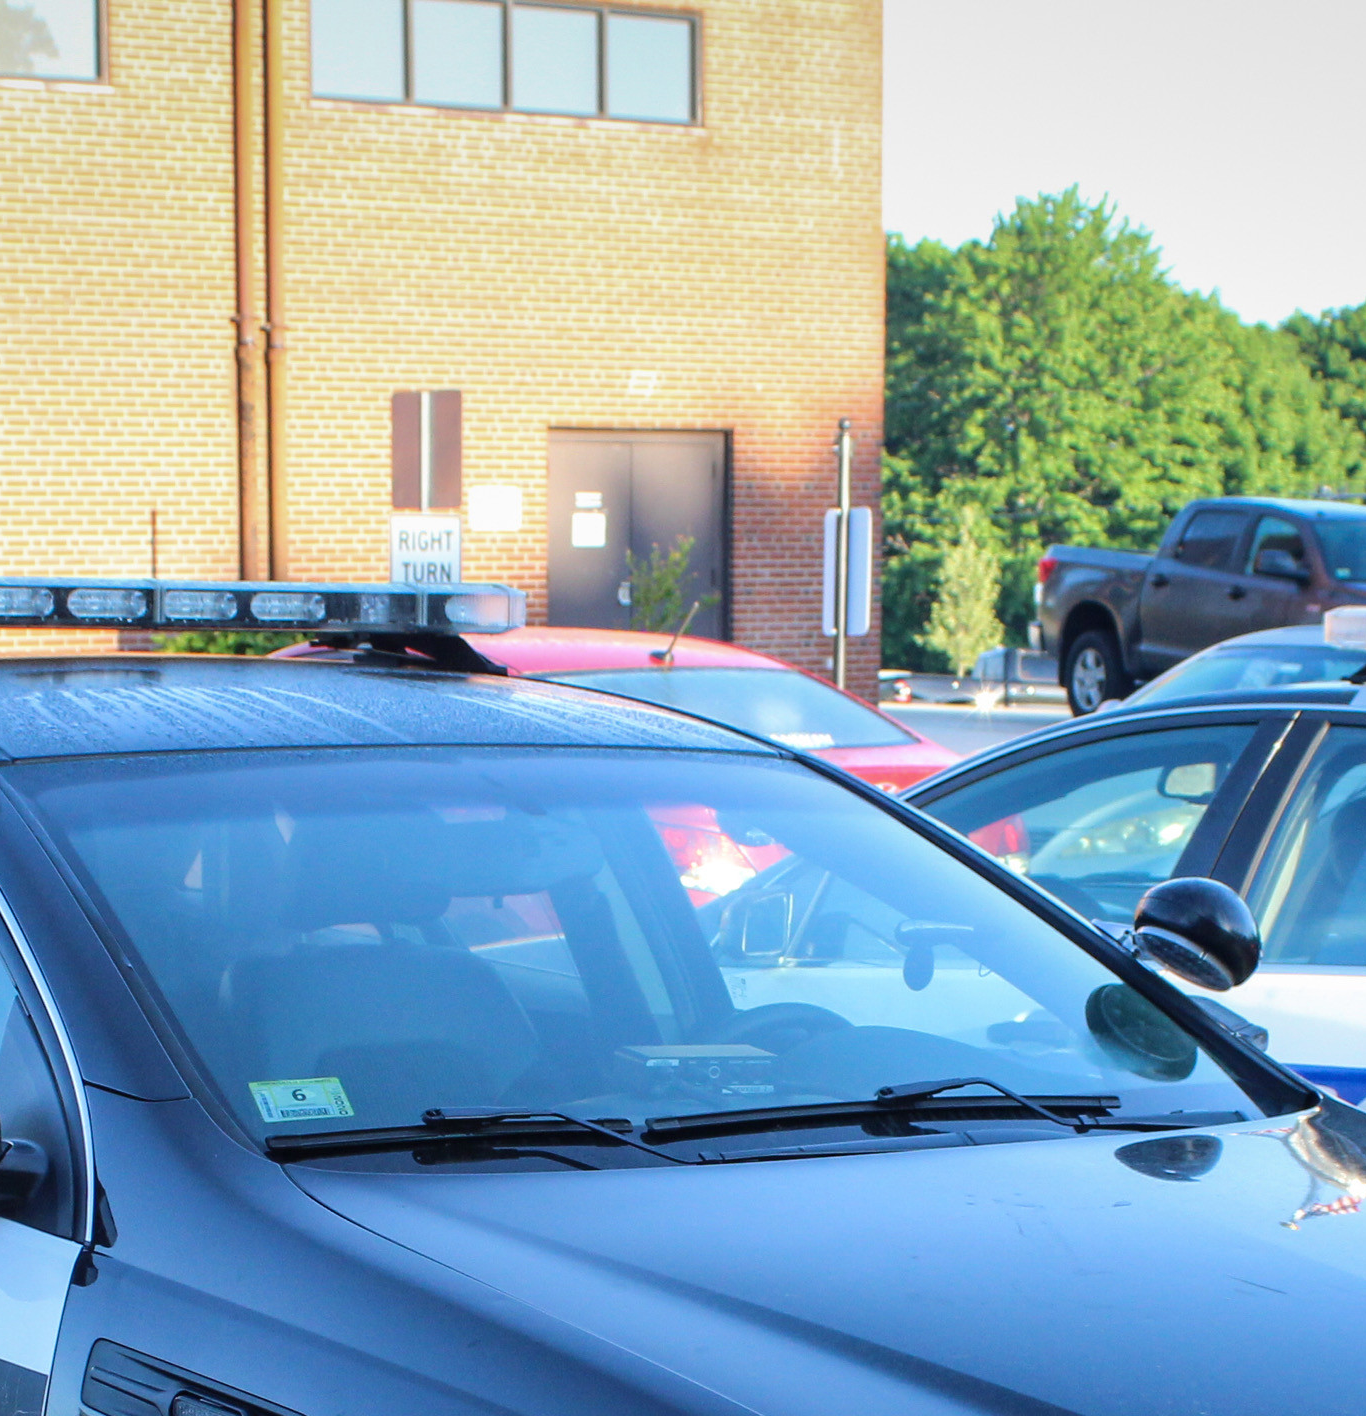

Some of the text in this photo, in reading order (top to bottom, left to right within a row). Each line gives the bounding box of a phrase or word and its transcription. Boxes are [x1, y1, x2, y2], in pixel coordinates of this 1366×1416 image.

[398, 530, 454, 552] RIGHT
[401, 561, 453, 583] TURN
[291, 1088, 307, 1102] 6
